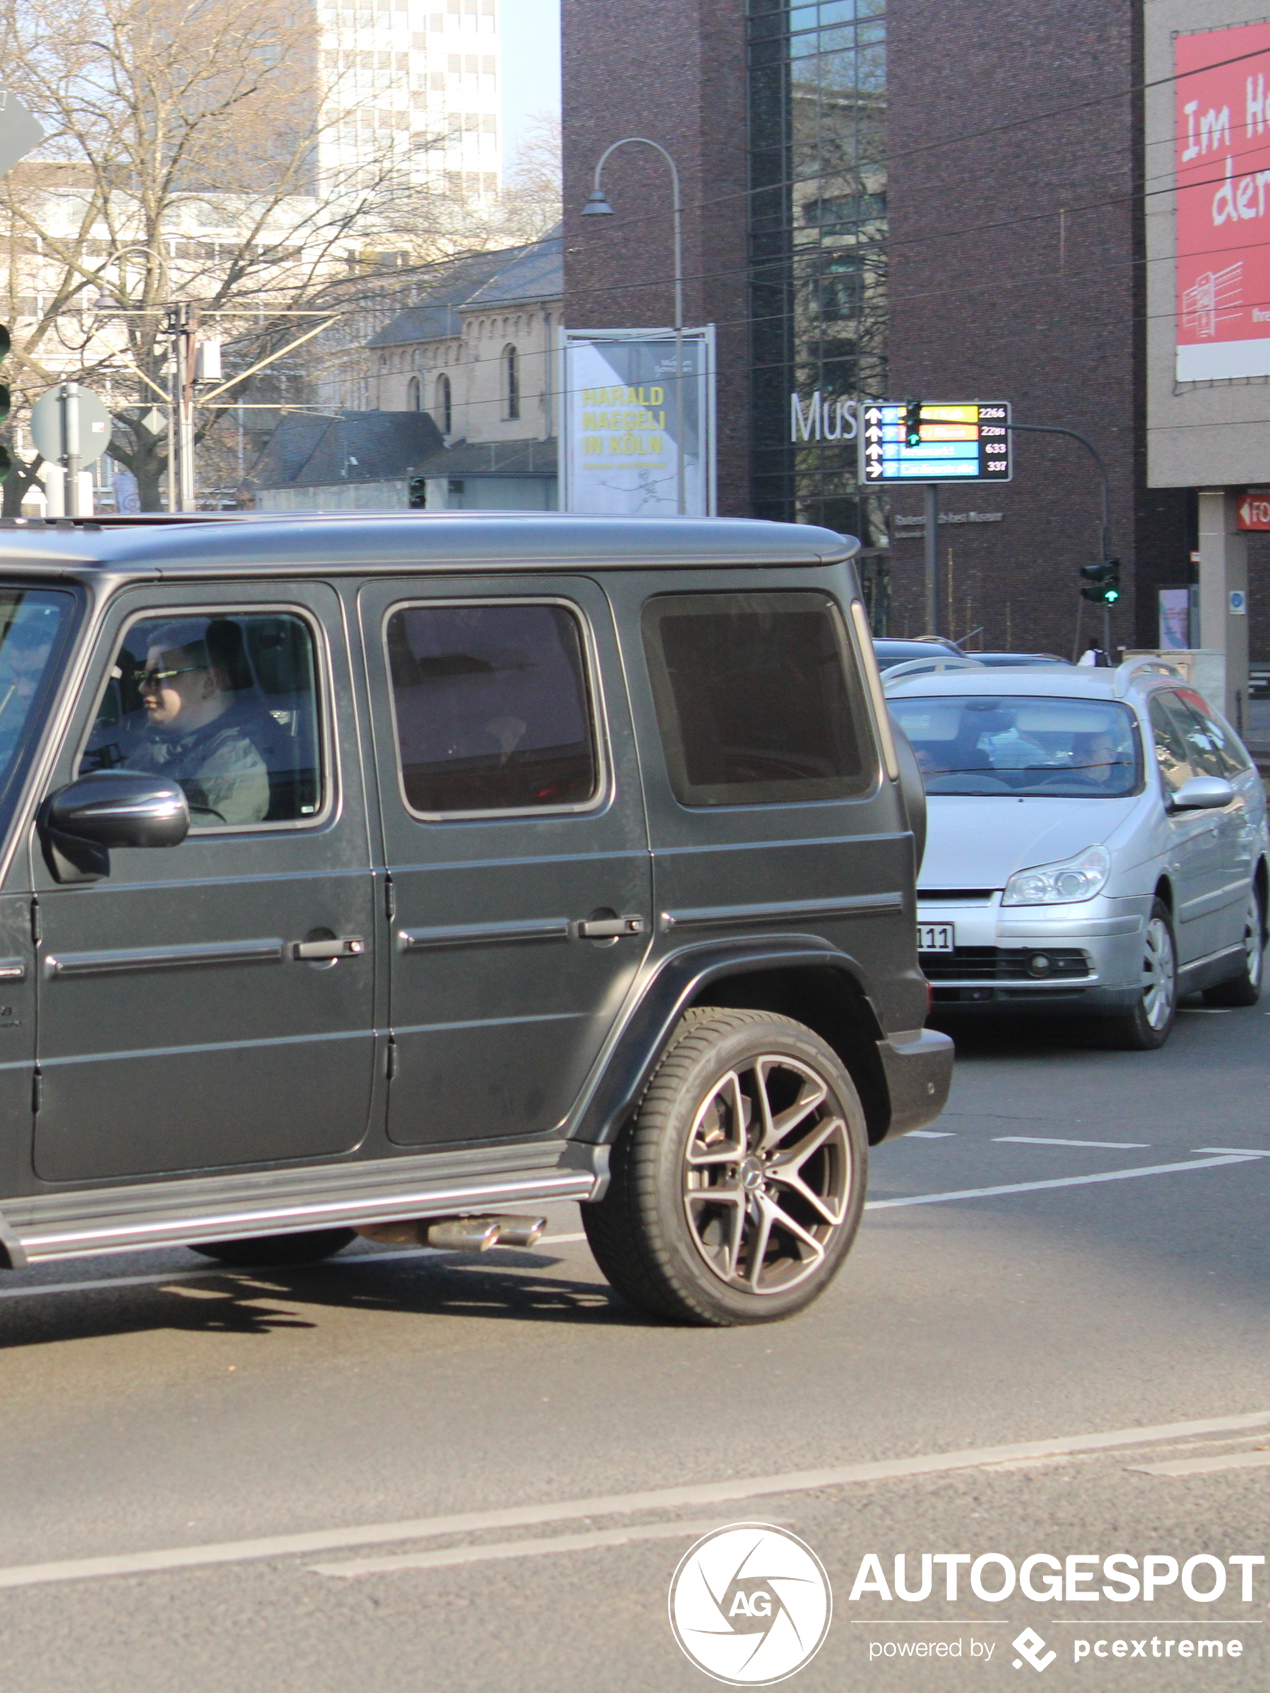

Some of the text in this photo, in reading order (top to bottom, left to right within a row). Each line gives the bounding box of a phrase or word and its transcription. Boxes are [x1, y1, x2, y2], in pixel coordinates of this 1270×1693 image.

[1182, 100, 1230, 162] Im
[582, 386, 665, 406] HARALD
[582, 411, 666, 430] NAEGELI
[791, 391, 858, 442] Mus
[582, 430, 663, 455] IN KÖLN
[985, 443, 1007, 454] 633
[987, 461, 1007, 471] 337
